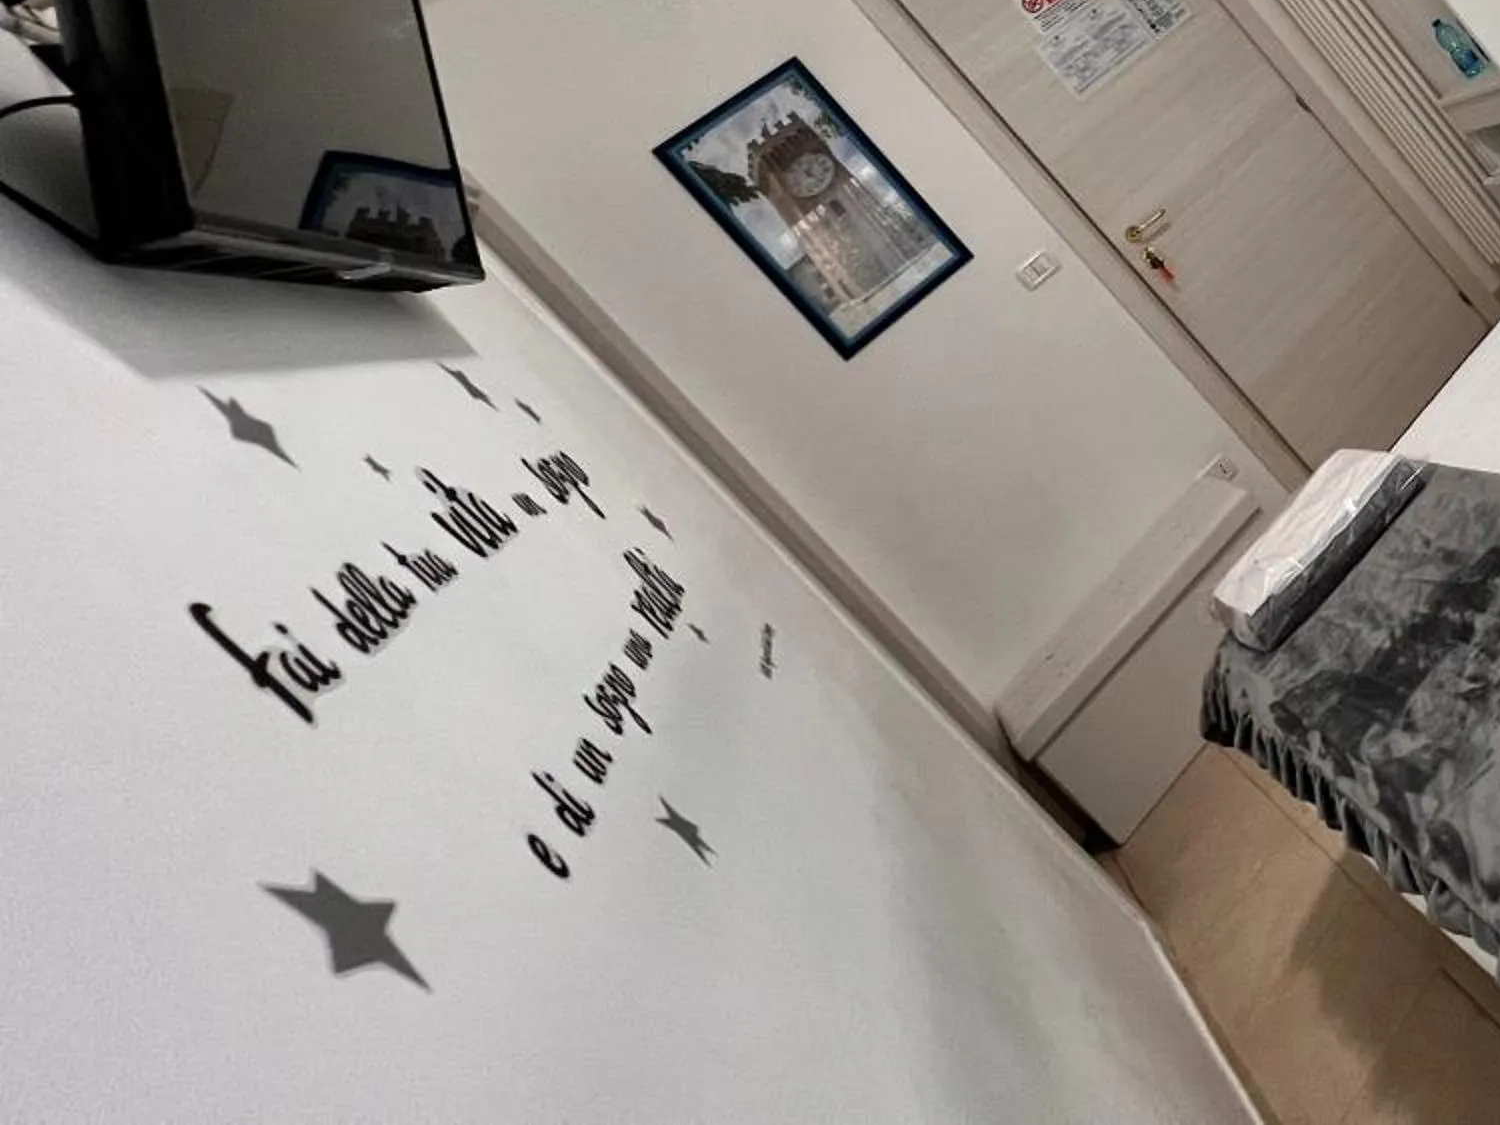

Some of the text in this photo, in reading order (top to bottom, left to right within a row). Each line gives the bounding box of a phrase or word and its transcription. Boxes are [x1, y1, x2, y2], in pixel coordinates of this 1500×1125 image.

[418, 467, 518, 559] vita
[380, 541, 458, 592] tua
[309, 562, 417, 654] della
[582, 661, 652, 736] sogno
[572, 736, 613, 785] un
[531, 771, 596, 837] di
[526, 833, 571, 880] e
